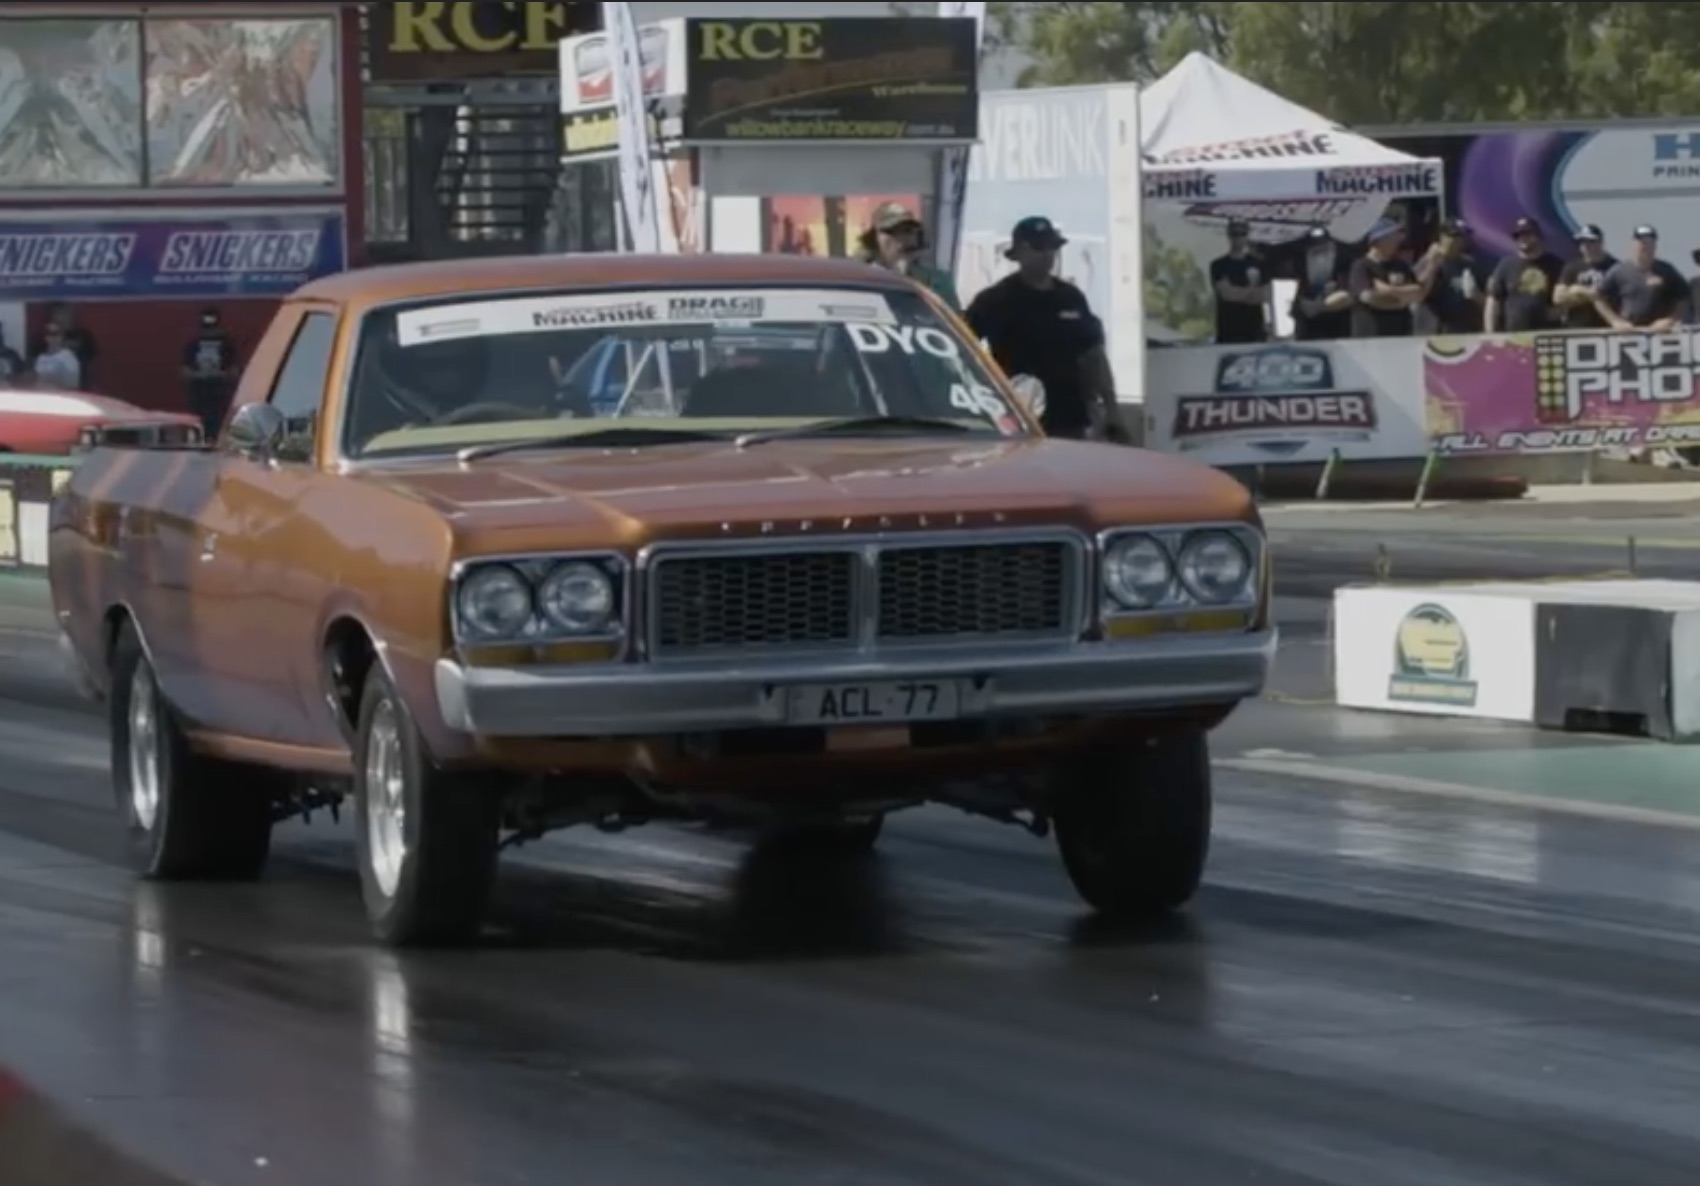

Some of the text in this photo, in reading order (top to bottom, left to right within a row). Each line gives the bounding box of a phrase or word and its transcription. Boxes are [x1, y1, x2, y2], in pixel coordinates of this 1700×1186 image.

[388, 2, 580, 52] RCE
[699, 21, 822, 60] RCE
[1316, 169, 1437, 194] MACHINE
[0, 236, 131, 273] NICKERS
[166, 232, 313, 272] SNICKERS
[845, 323, 958, 358] DYO
[1566, 335, 1700, 366] DRA
[1221, 353, 1325, 388] 400
[1568, 366, 1700, 420] PHO
[1183, 395, 1368, 429] THUNDER
